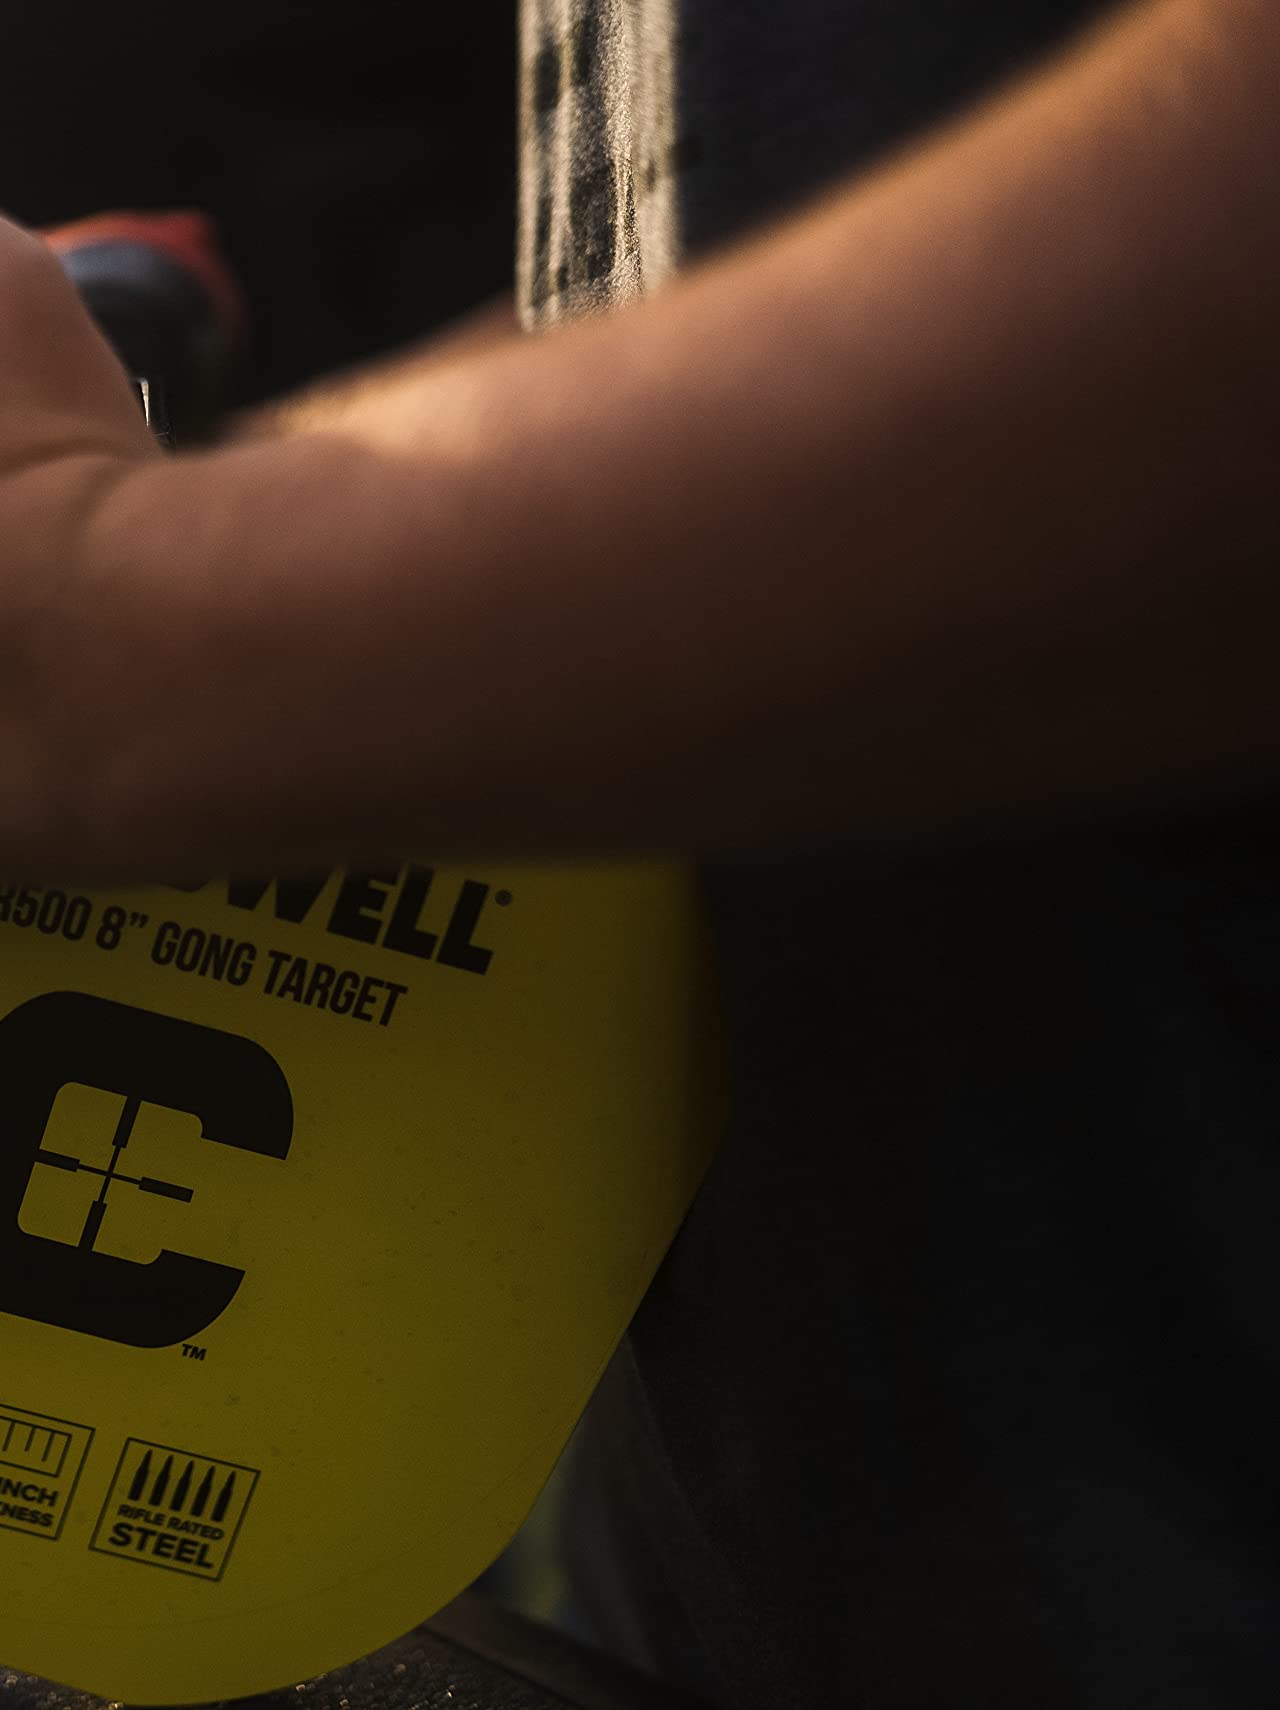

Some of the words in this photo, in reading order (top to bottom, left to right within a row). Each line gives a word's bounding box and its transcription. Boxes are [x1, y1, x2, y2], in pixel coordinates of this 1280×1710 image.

[151, 922, 257, 986] GONG
[263, 950, 408, 1027] TARGET
[108, 1522, 214, 1568] STEEL
[117, 1504, 166, 1526] RIFLE
[168, 1517, 224, 1541] RATED
